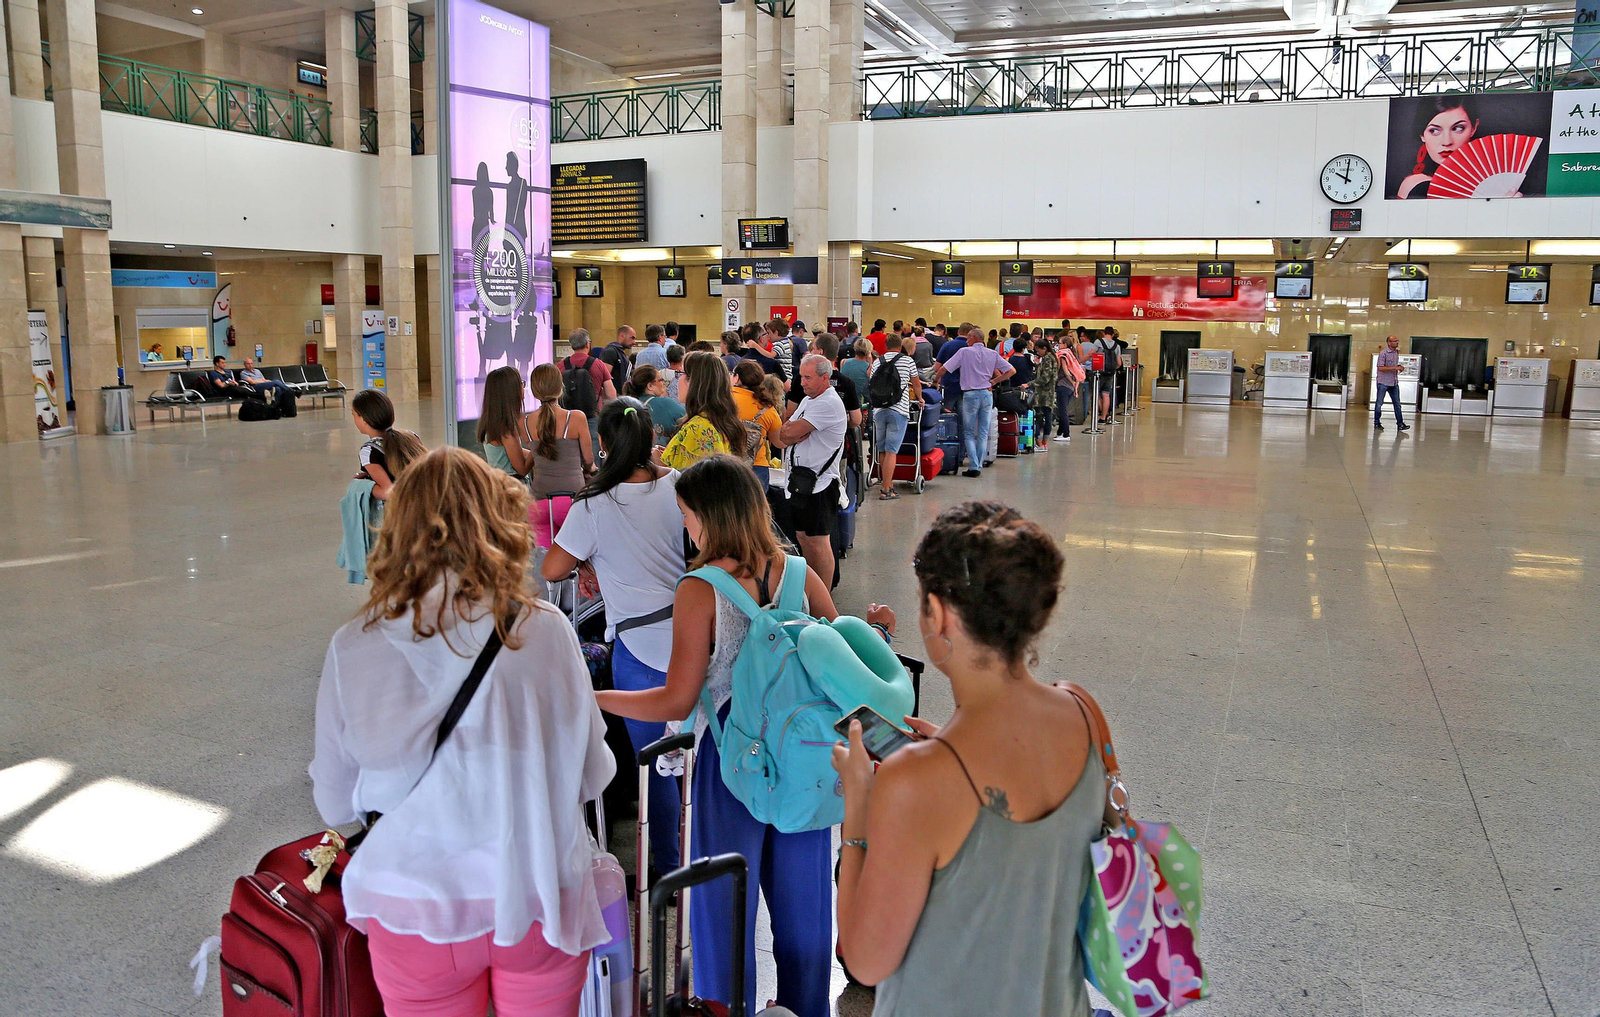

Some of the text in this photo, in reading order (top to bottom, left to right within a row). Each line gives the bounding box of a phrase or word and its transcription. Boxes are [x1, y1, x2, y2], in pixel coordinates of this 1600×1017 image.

[479, 13, 525, 38] JCDecaux Airport
[1568, 104, 1585, 119] A
[1559, 126, 1598, 137] at the
[560, 164, 586, 172] LLEGADAS
[560, 170, 582, 178] ARRIVALS
[484, 248, 517, 268] +200
[486, 268, 517, 277] MILLONES
[585, 268, 592, 279] 3
[667, 268, 675, 278] 4
[862, 264, 868, 274] 7
[944, 263, 953, 274] 8
[1012, 263, 1021, 274] 9
[1105, 264, 1121, 275] 10
[1208, 264, 1224, 275] 11
[1286, 264, 1303, 275] 12
[1400, 266, 1417, 278] 13
[1519, 267, 1538, 279] 14
[1147, 301, 1189, 309] Facturación
[1147, 309, 1177, 318] Check-in
